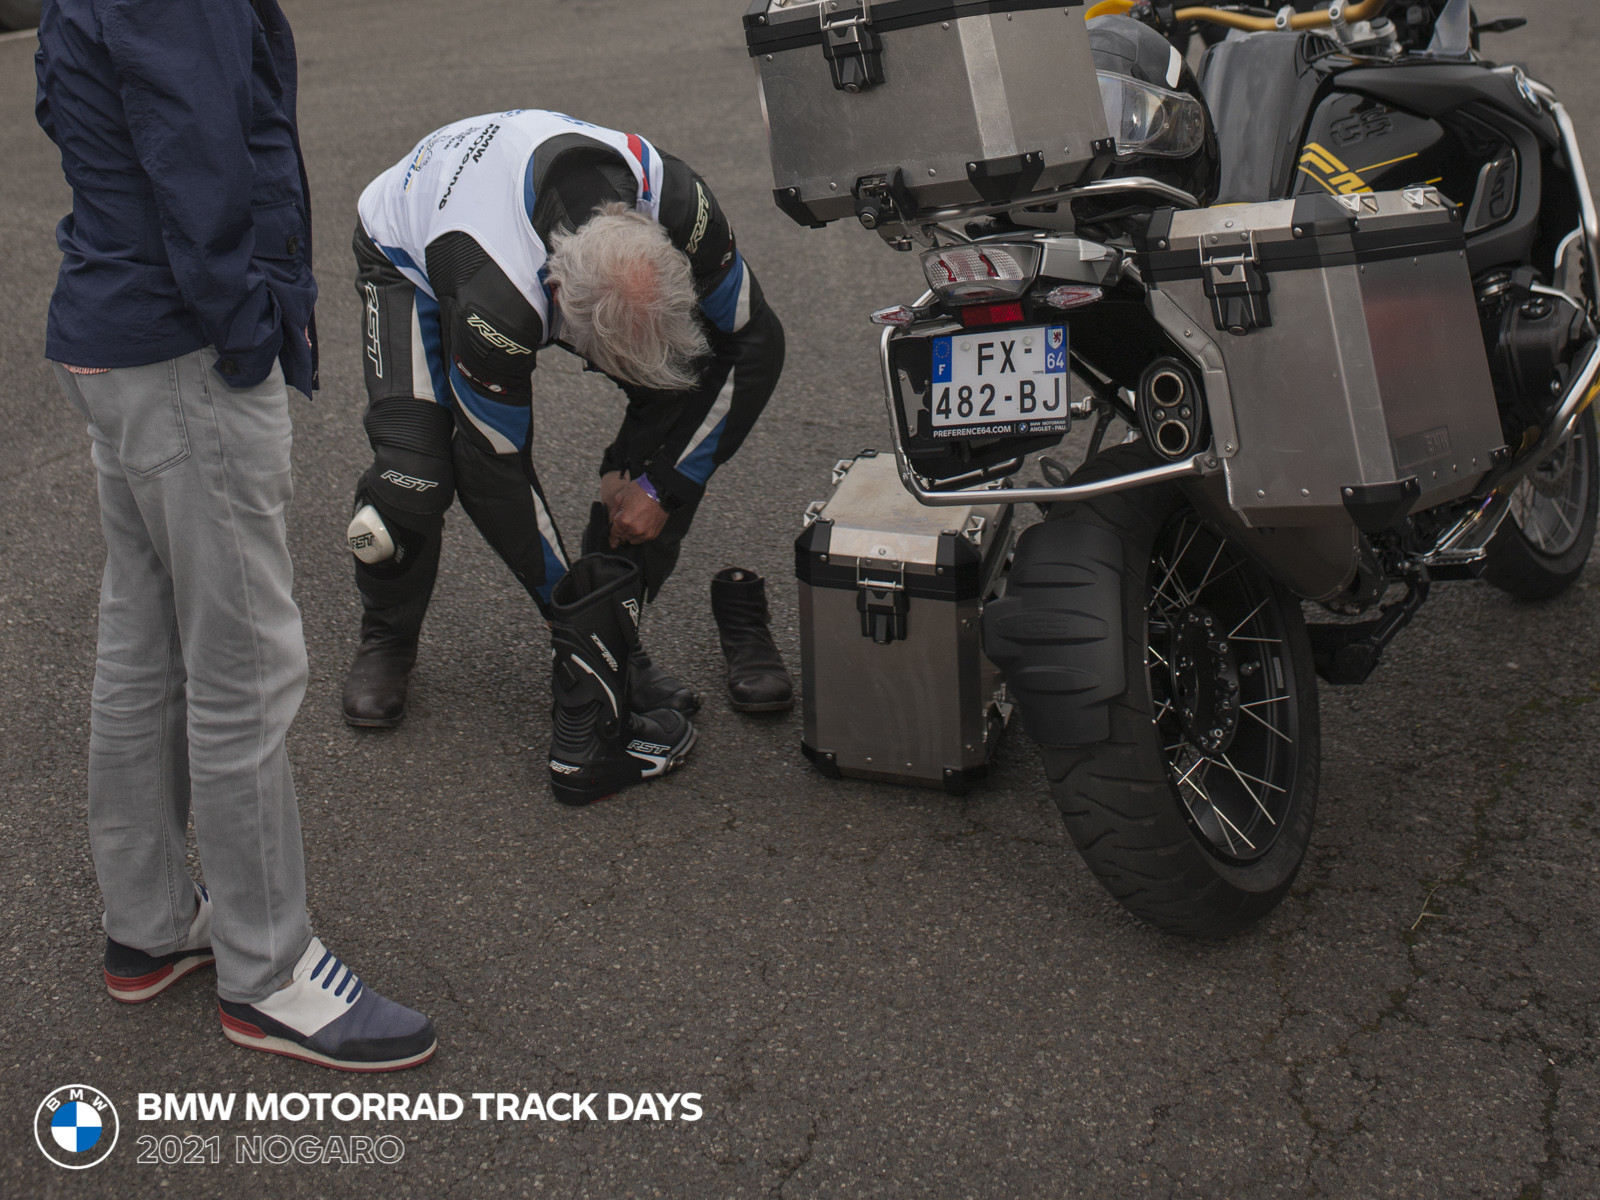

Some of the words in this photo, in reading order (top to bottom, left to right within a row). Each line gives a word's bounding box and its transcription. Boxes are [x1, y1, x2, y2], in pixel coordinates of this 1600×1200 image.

[473, 125, 500, 163] BMW
[439, 123, 495, 210] MOTORRAD
[685, 182, 709, 255] RST
[363, 281, 383, 379] RST
[467, 313, 532, 354] RST
[938, 364, 946, 376] F
[1047, 352, 1065, 369] 64
[936, 377, 1060, 420] 482-BJ
[933, 425, 1011, 438] PREFERENCE64.COM
[381, 469, 439, 492] RST
[350, 531, 375, 550] RST
[627, 739, 672, 755] RST
[549, 759, 580, 775] RST
